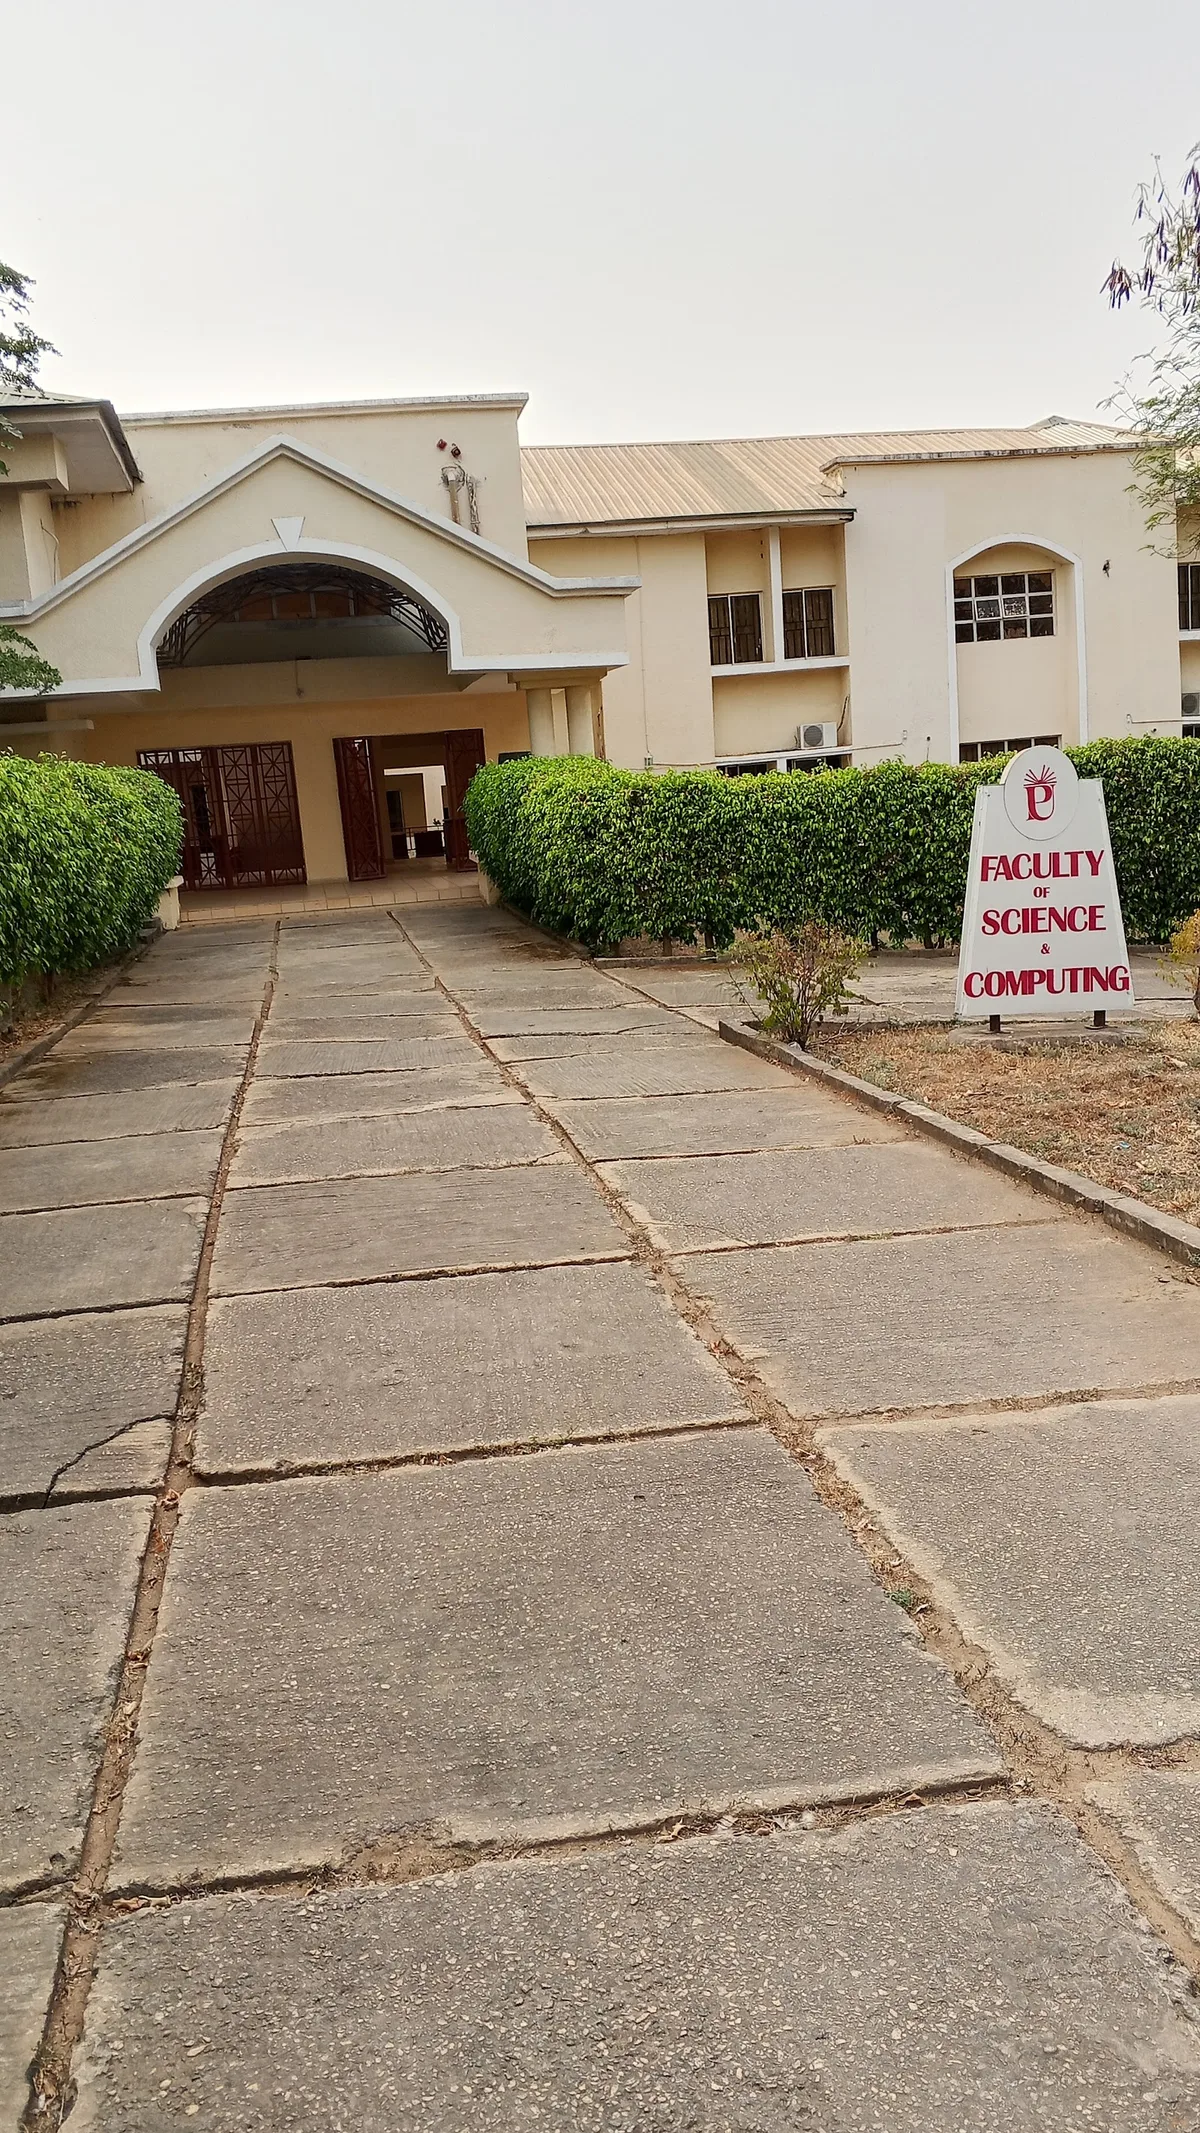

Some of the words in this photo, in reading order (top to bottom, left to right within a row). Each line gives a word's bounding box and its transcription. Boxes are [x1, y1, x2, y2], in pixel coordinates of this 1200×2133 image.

[980, 850, 1105, 882] FACULTY
[1033, 887, 1050, 898] OF
[981, 905, 1106, 936] SCIENCE
[1040, 943, 1051, 955] &
[963, 965, 1131, 998] COMPUTING
